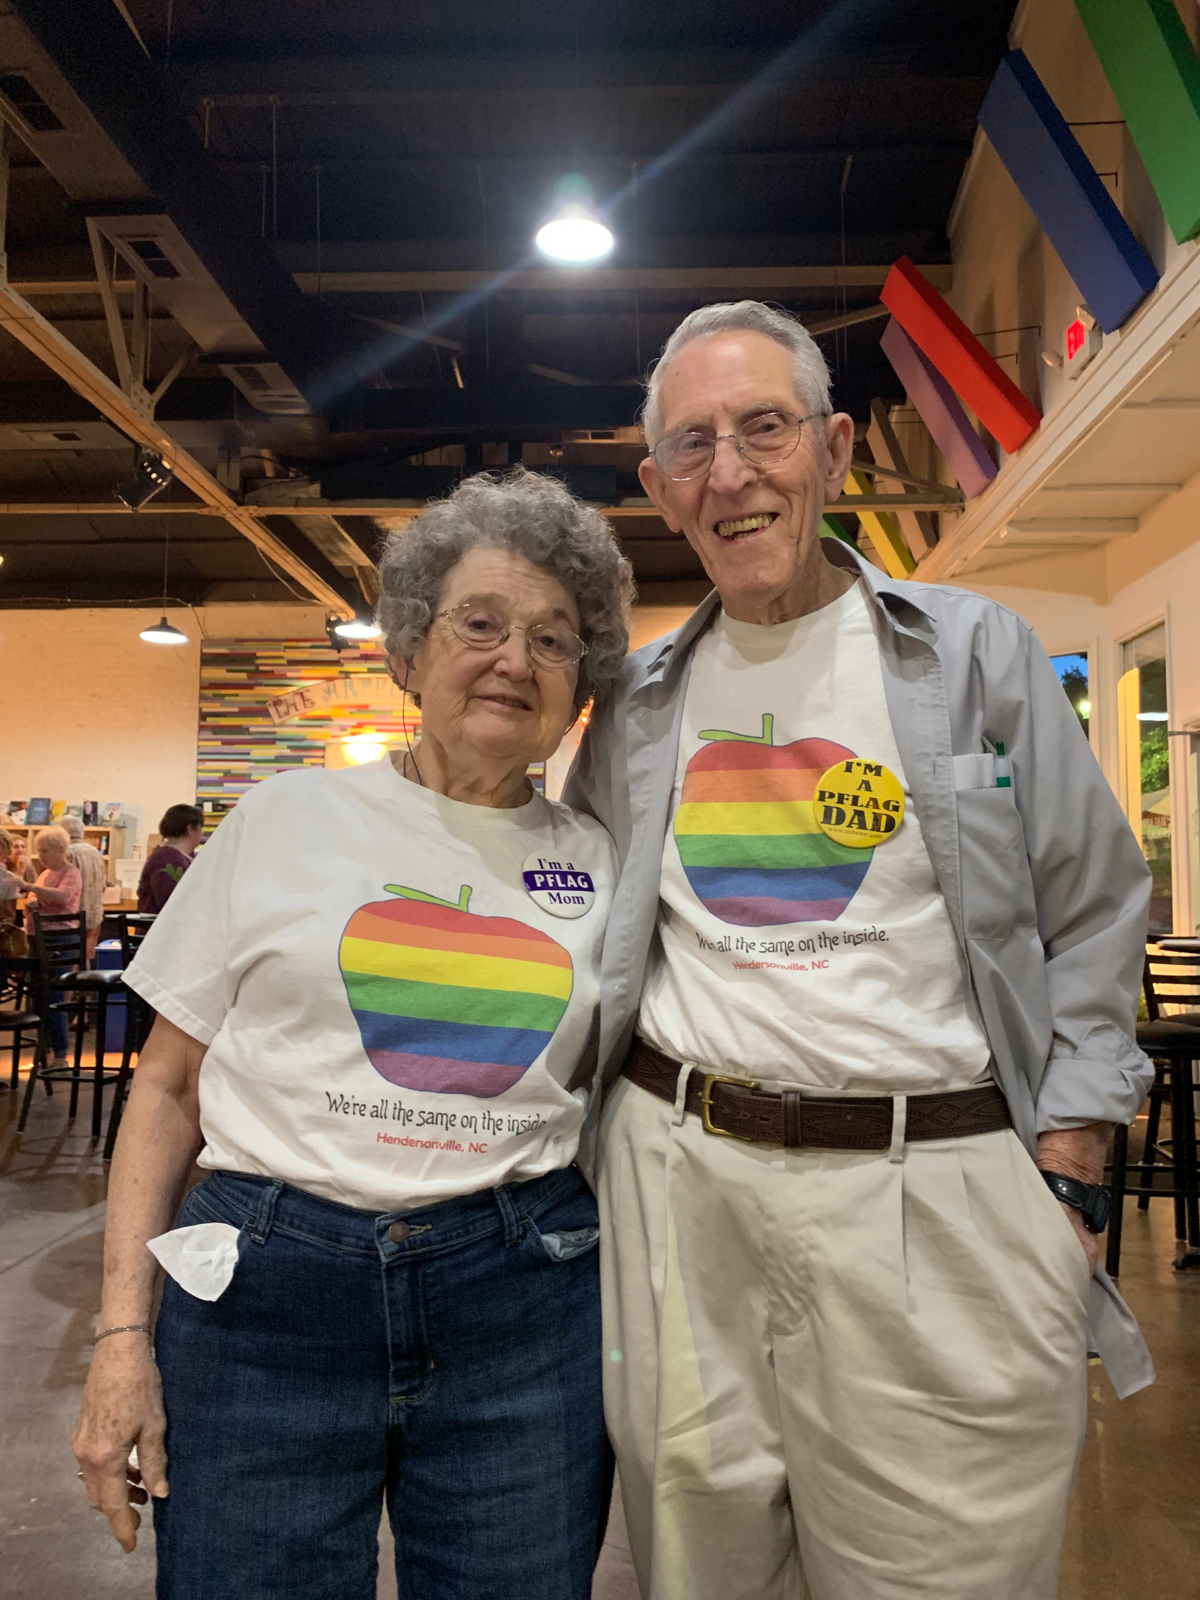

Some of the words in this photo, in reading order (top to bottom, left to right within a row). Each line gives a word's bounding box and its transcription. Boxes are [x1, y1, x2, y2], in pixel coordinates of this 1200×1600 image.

[843, 761, 884, 777] I'M
[856, 779, 873, 792] A
[817, 790, 901, 812] PFLAG
[820, 805, 896, 833] DAD
[537, 858, 563, 870] I'm
[566, 862, 575, 871] a
[533, 874, 589, 888] PFLAG
[547, 892, 585, 905] Mom
[717, 935, 732, 952] all
[735, 937, 756, 951] the
[758, 938, 795, 956] same
[799, 938, 816, 953] on
[818, 931, 840, 951] the
[842, 925, 889, 946] inside.
[811, 959, 830, 970] NC
[325, 1091, 366, 1116] We're
[370, 1099, 389, 1120] all
[392, 1100, 413, 1126] the
[416, 1109, 456, 1131] same
[461, 1113, 477, 1133] on
[482, 1110, 503, 1136] the
[376, 1132, 465, 1154] Hendersonville,
[468, 1142, 488, 1154] NC
